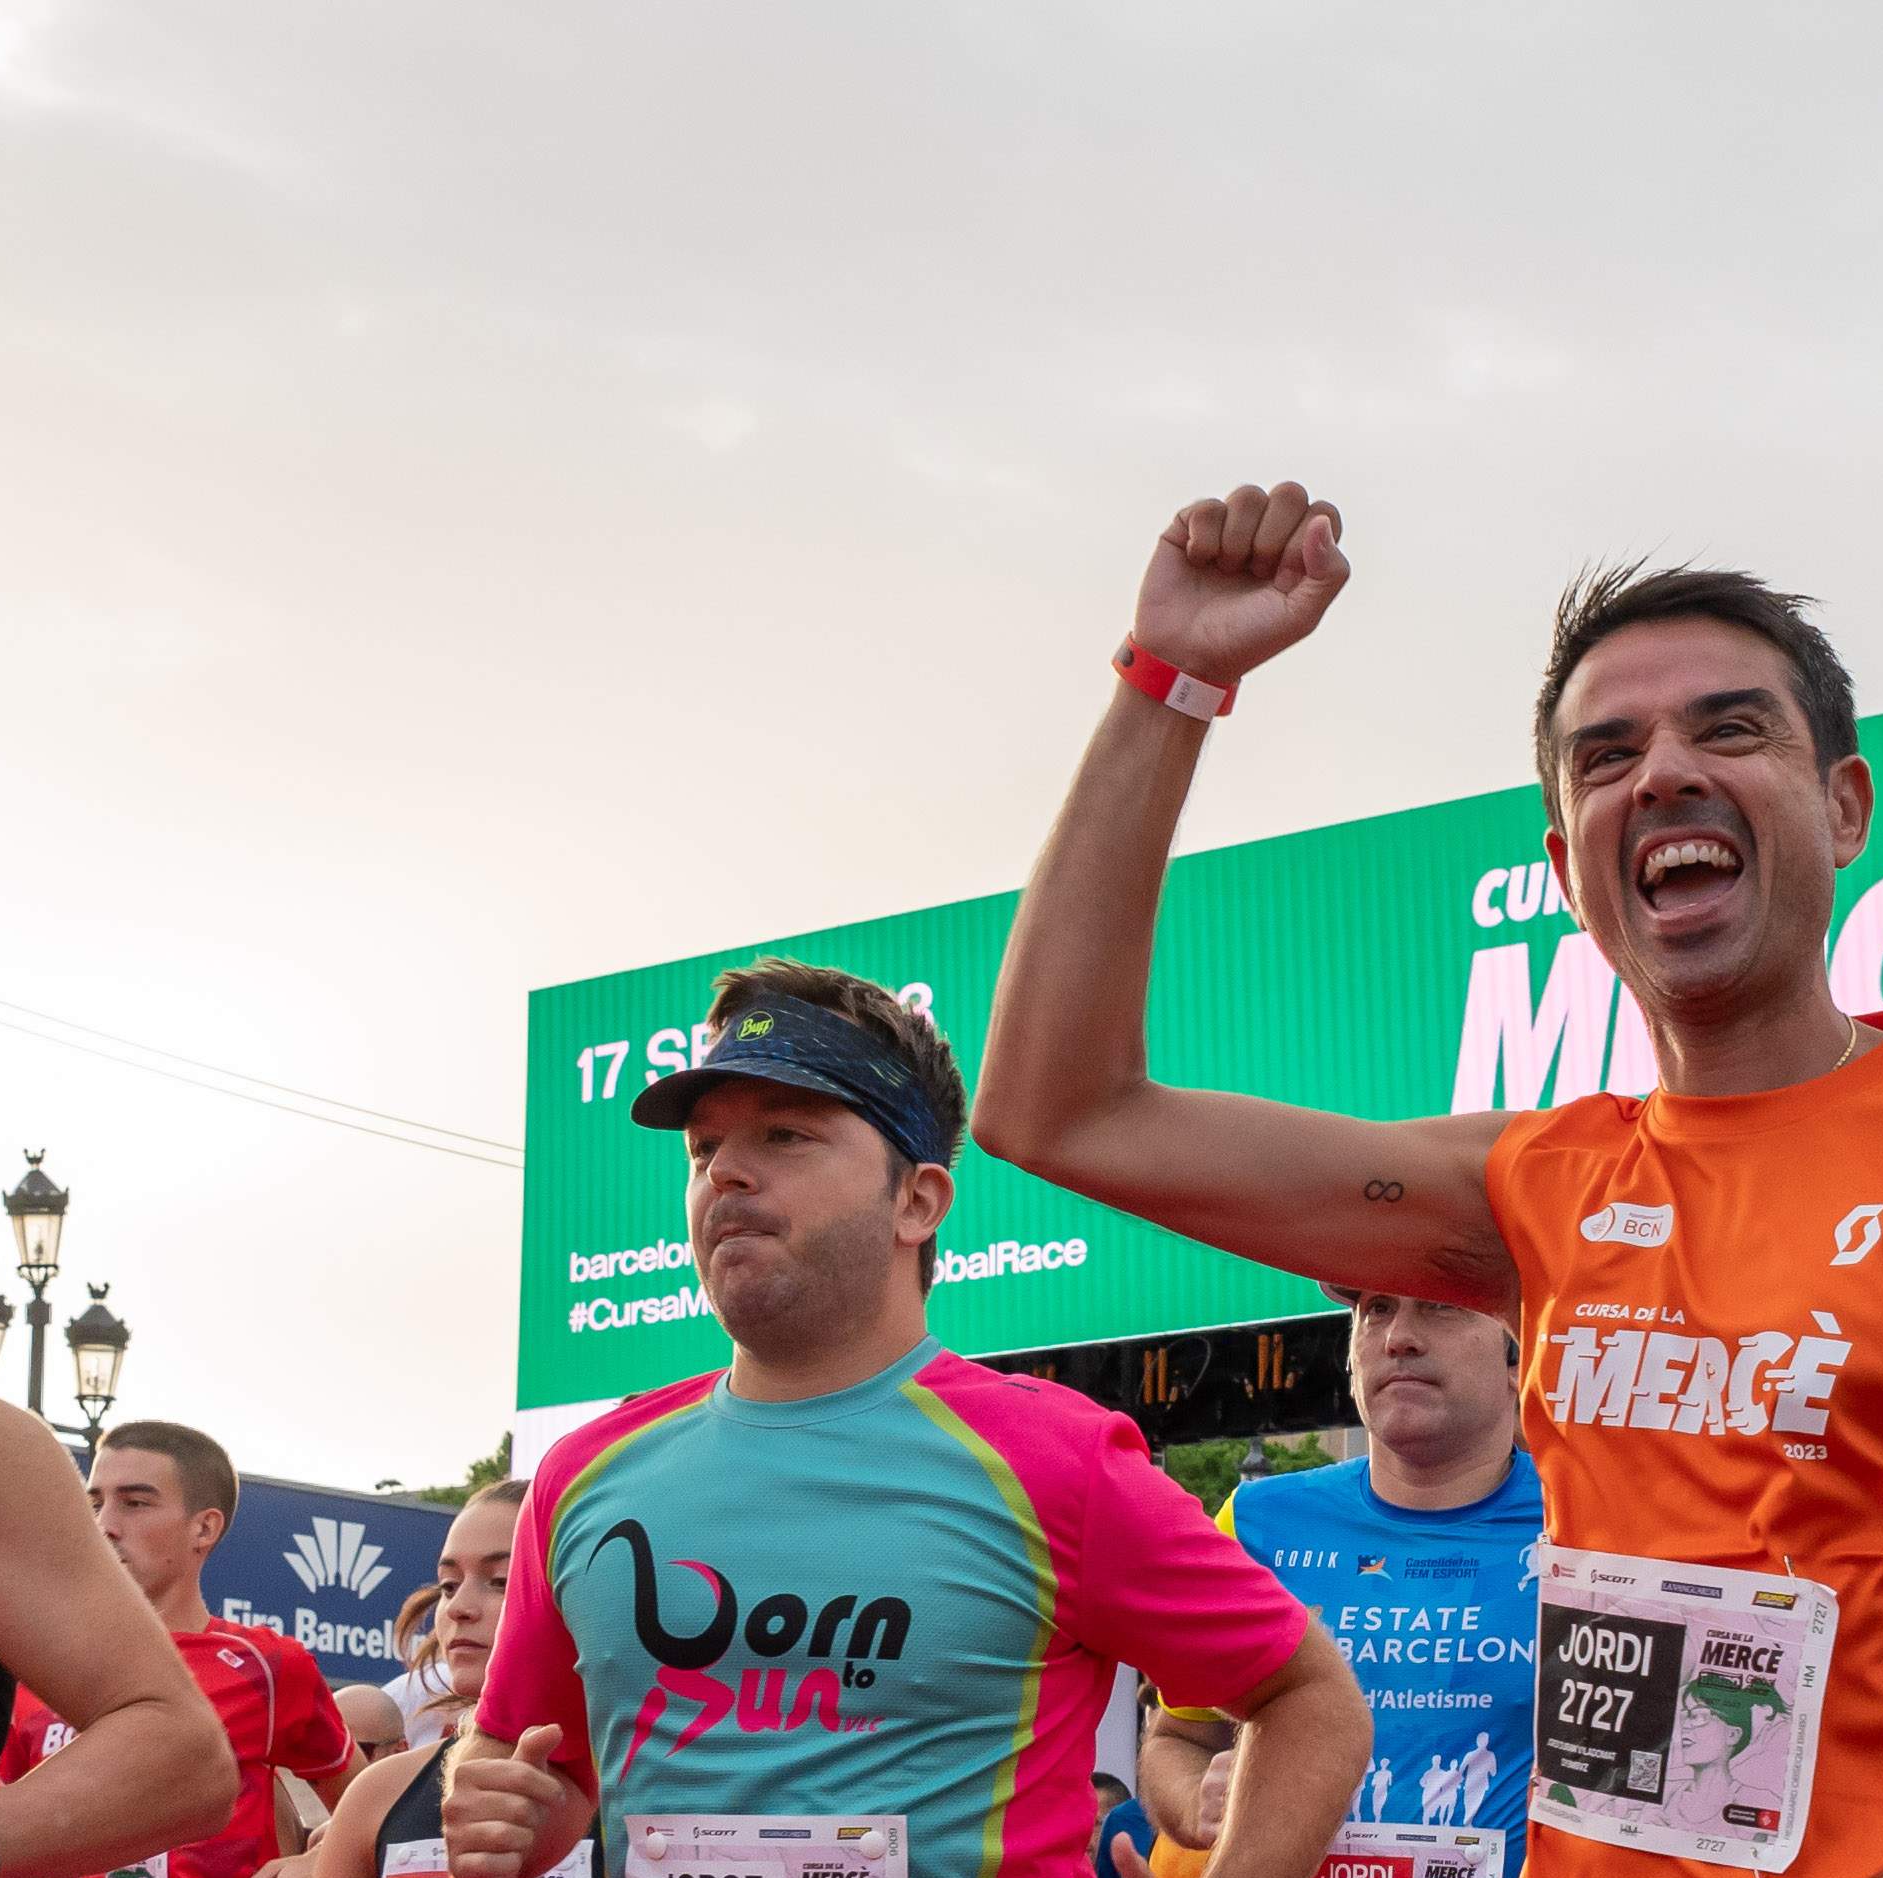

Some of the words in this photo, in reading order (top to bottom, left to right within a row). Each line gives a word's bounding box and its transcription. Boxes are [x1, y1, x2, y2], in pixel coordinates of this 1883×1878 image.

[577, 1040, 631, 1104] 17
[1623, 1219, 1663, 1238] BCN
[1575, 1303, 1629, 1319] CURSA
[1635, 1306, 1656, 1321] DE
[1661, 1307, 1686, 1325] LA
[1546, 1310, 1854, 1436] MERCÈ
[1782, 1443, 1828, 1461] 2023
[1274, 1549, 1339, 1569] GOBIK
[1339, 1606, 1481, 1632] ESTATE
[1811, 1601, 1829, 1636] 2727
[1558, 1623, 1654, 1677] JORDI
[1699, 1639, 1786, 1675] MERCÈ
[843, 1660, 876, 1689] to
[1800, 1664, 1817, 1689] HM
[1558, 1678, 1635, 1733] 2727
[1696, 1837, 1726, 1853] 2727
